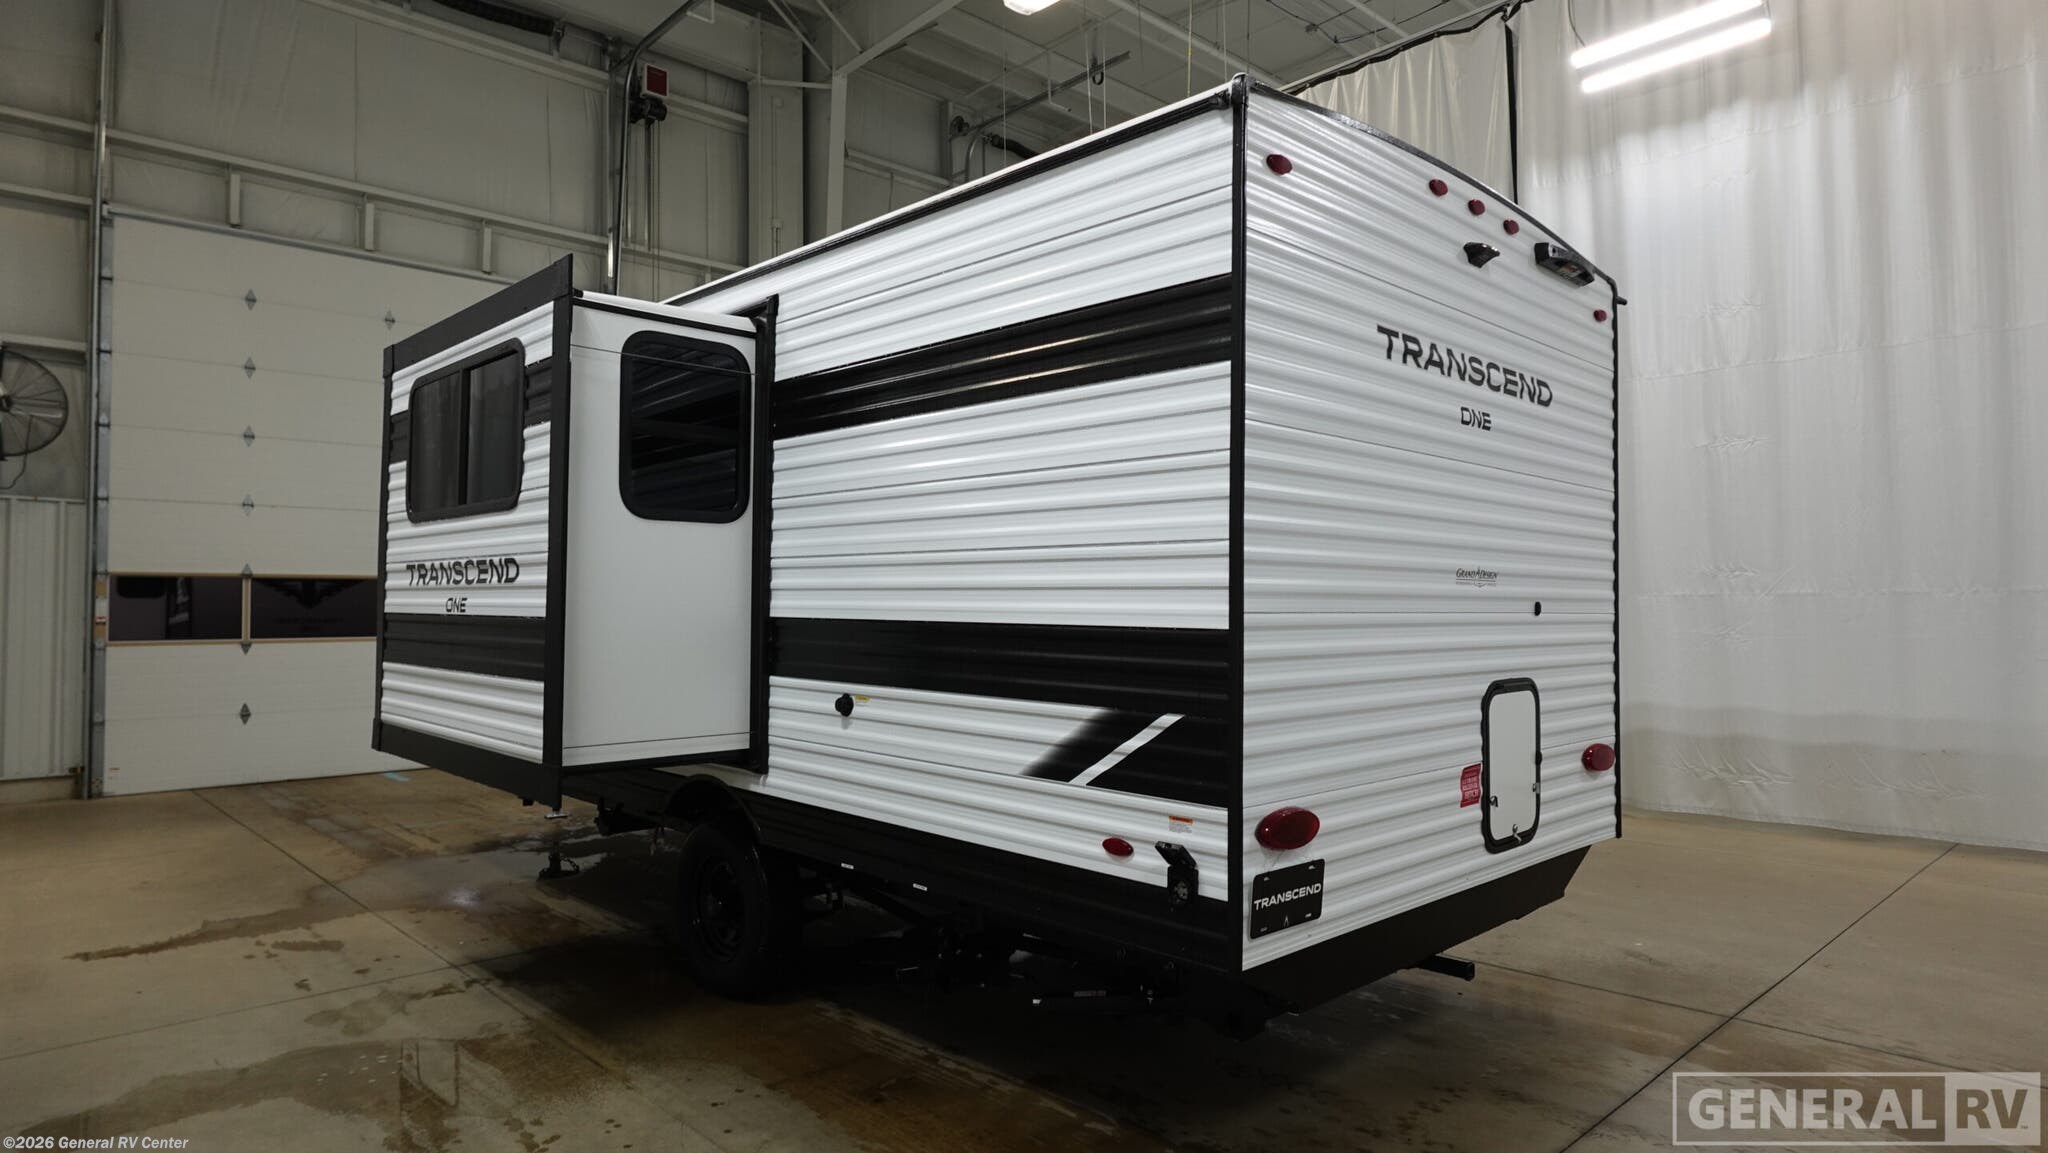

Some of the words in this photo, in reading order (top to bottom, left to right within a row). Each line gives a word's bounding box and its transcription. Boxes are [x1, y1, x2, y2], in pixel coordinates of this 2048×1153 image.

[1377, 324, 1553, 407] TRANSCEND
[406, 557, 520, 587] TRANSCEND
[445, 597, 468, 613] ONE
[1254, 883, 1321, 910] TRANSCEND
